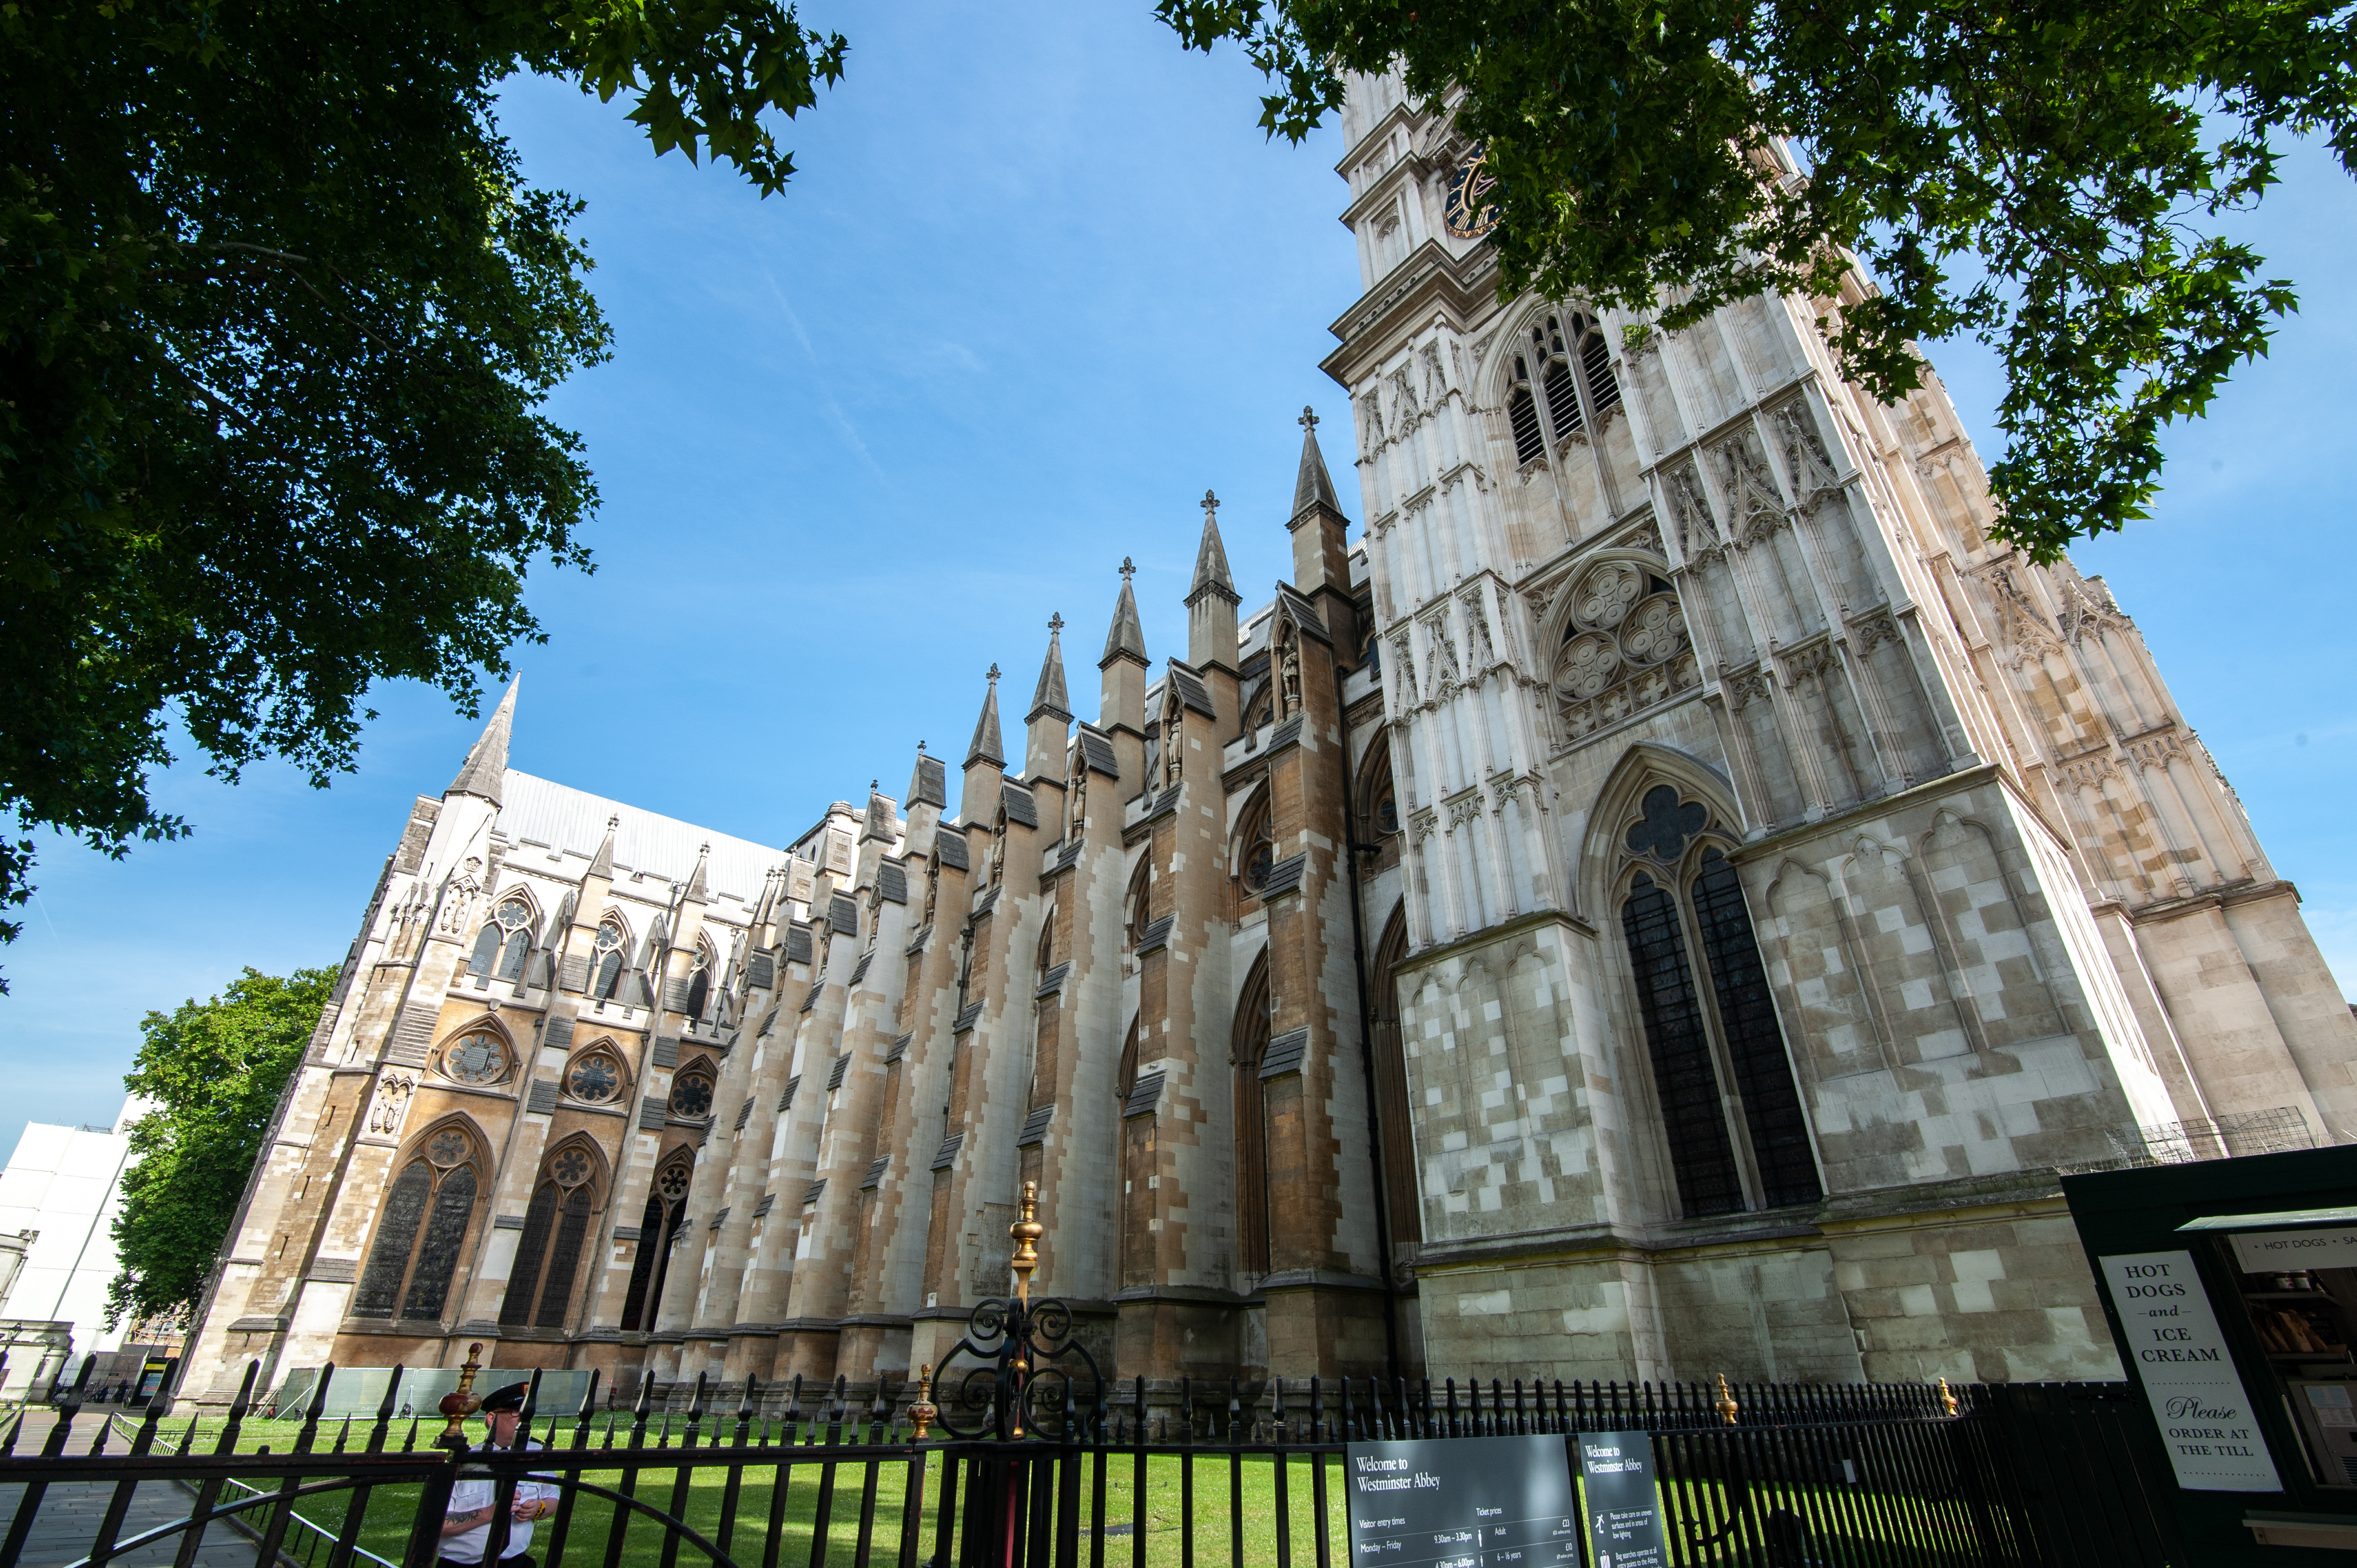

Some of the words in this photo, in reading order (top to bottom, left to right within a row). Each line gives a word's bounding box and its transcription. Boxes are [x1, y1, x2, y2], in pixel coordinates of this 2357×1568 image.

[2264, 1241, 2288, 1250] HOT
[2292, 1239, 2326, 1248] DOGS
[2123, 1264, 2170, 1278] HOT
[2124, 1283, 2186, 1298] DOGS
[2152, 1328, 2191, 1341] ICE
[2141, 1348, 2221, 1362] CREAM
[2166, 1396, 2237, 1419] Please
[2169, 1428, 2226, 1438] ORDER
[2231, 1429, 2249, 1439] AT
[1585, 1445, 1613, 1457] Welcome
[1613, 1447, 1620, 1456] to
[2177, 1445, 2212, 1455] THE
[2214, 1446, 2254, 1456] TILL
[1356, 1456, 1396, 1472] Welcome
[1398, 1458, 1408, 1470] to
[1587, 1459, 1623, 1473] Westminster
[1625, 1458, 1642, 1473] Abbey
[1357, 1474, 1411, 1492] Westminster
[1414, 1472, 1440, 1490] Abbey
[1476, 1507, 1489, 1517] Ticket
[1490, 1507, 1502, 1517] prices
[1610, 1512, 1620, 1520] Please
[1359, 1519, 1376, 1528] Visitor
[1377, 1518, 1391, 1528] entry
[1392, 1517, 1405, 1525] times
[1495, 1526, 1506, 1536] Adult
[1619, 1530, 1632, 1540] lighting
[1434, 1535, 1451, 1544] 9.30am
[1456, 1531, 1472, 1543] 3.30pm
[1361, 1544, 1381, 1554] Monday
[1387, 1540, 1401, 1551] Friday
[1497, 1553, 1500, 1561] 6
[1505, 1551, 1510, 1560] 16
[1510, 1551, 1521, 1562] years
[1623, 1550, 1636, 1559] searches
[1636, 1549, 1649, 1558] operate
[1458, 1557, 1474, 1568] 6.00pm
[1627, 1560, 1636, 1568] points
